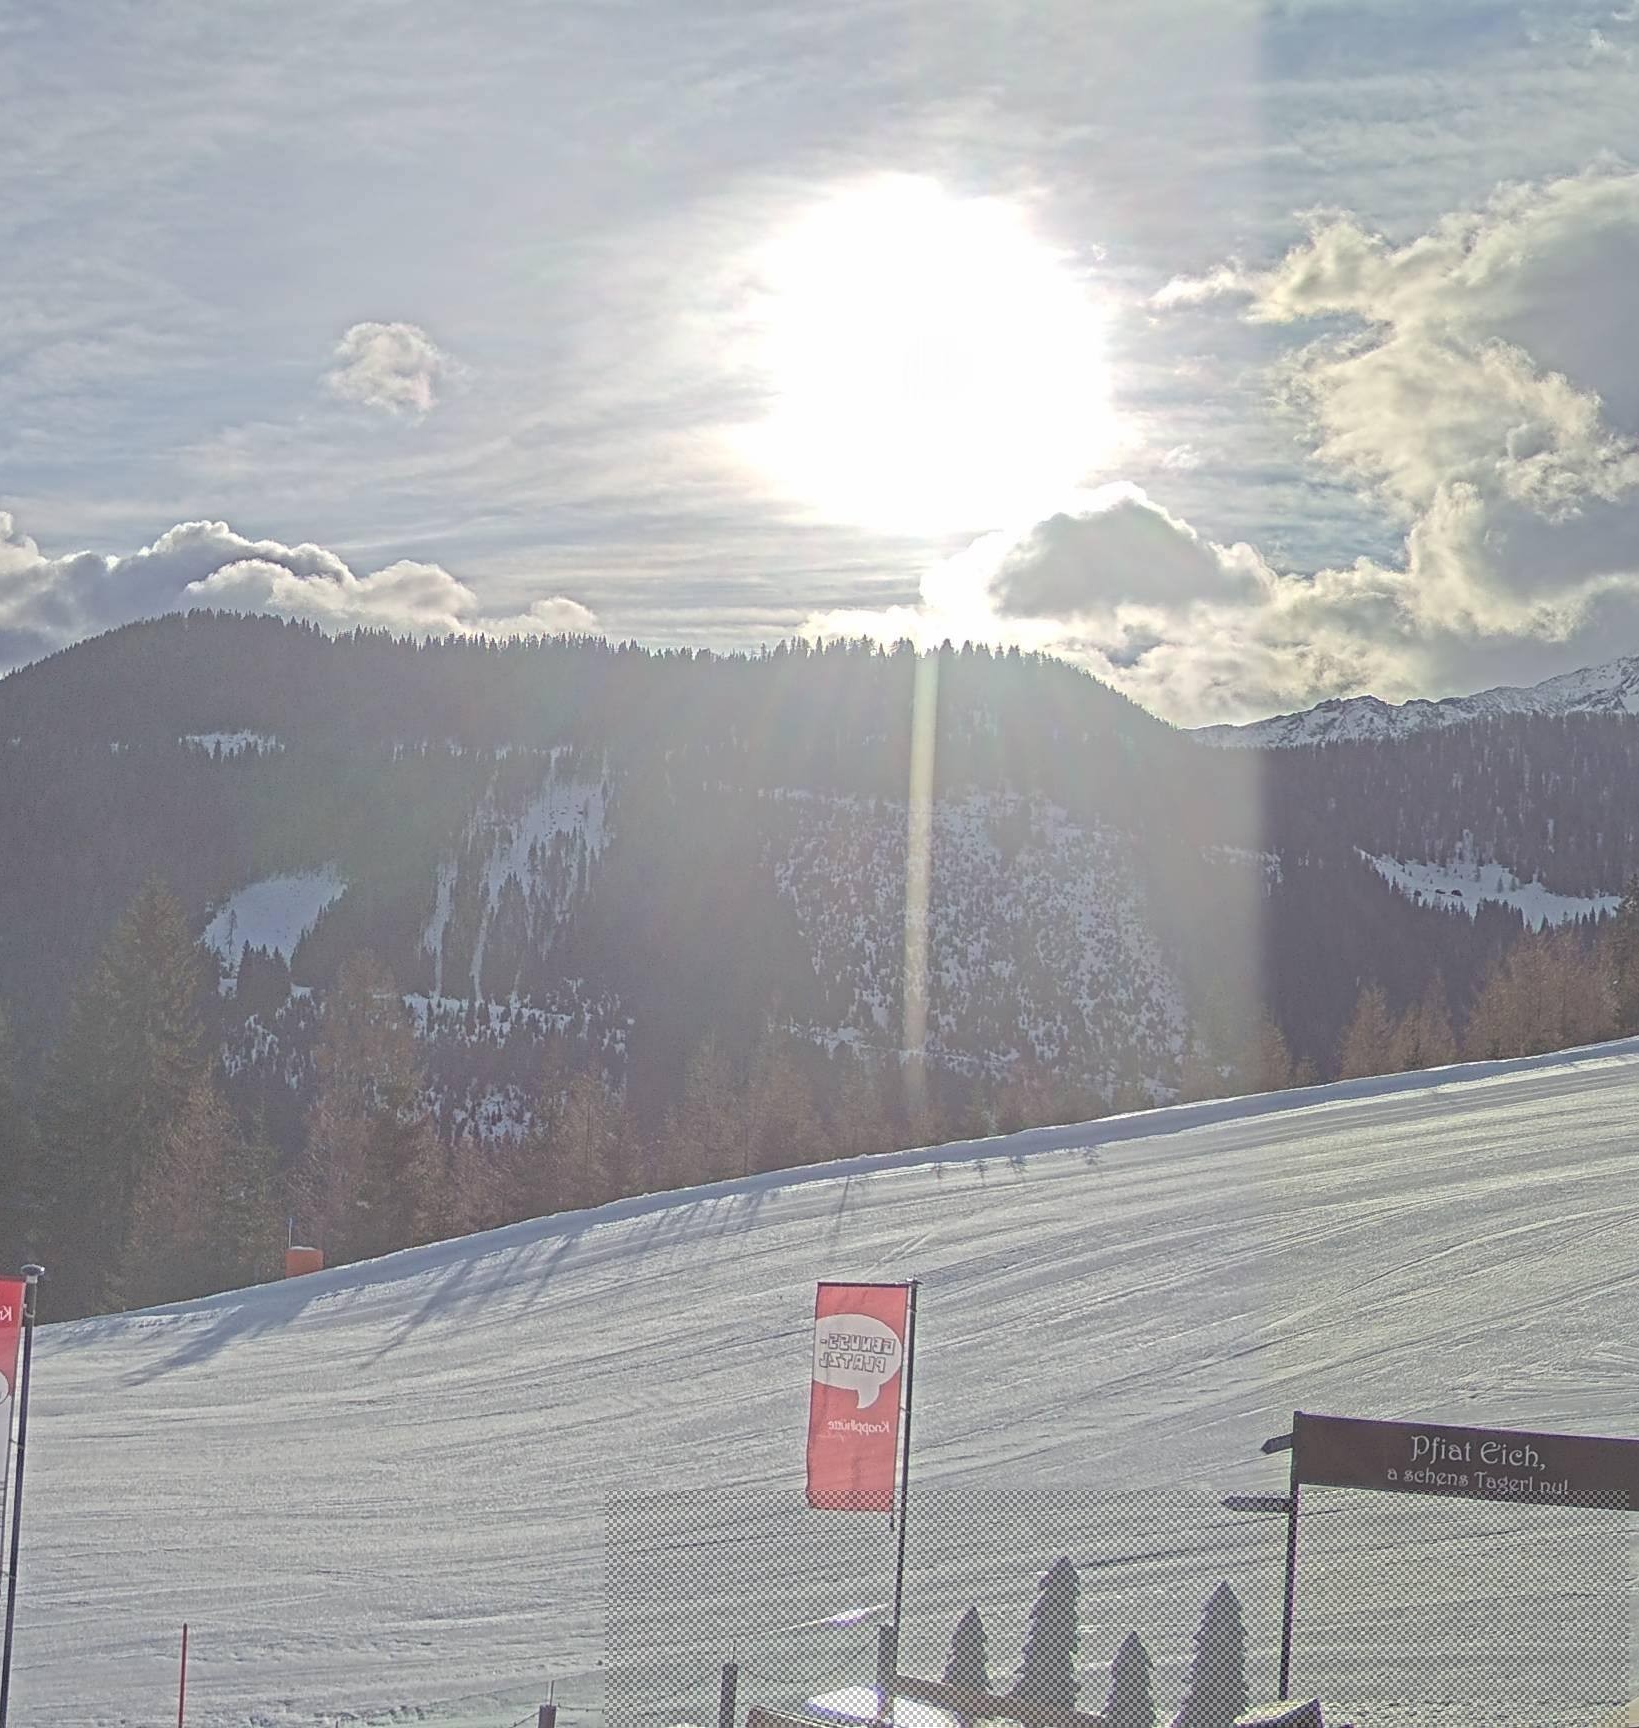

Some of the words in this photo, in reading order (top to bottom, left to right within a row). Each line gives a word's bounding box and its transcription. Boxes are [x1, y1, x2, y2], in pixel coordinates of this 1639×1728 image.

[1410, 1435, 1471, 1465] Pfiat
[1480, 1441, 1546, 1471] Eich,
[1387, 1468, 1398, 1481] a
[1474, 1471, 1533, 1494] Tagerl
